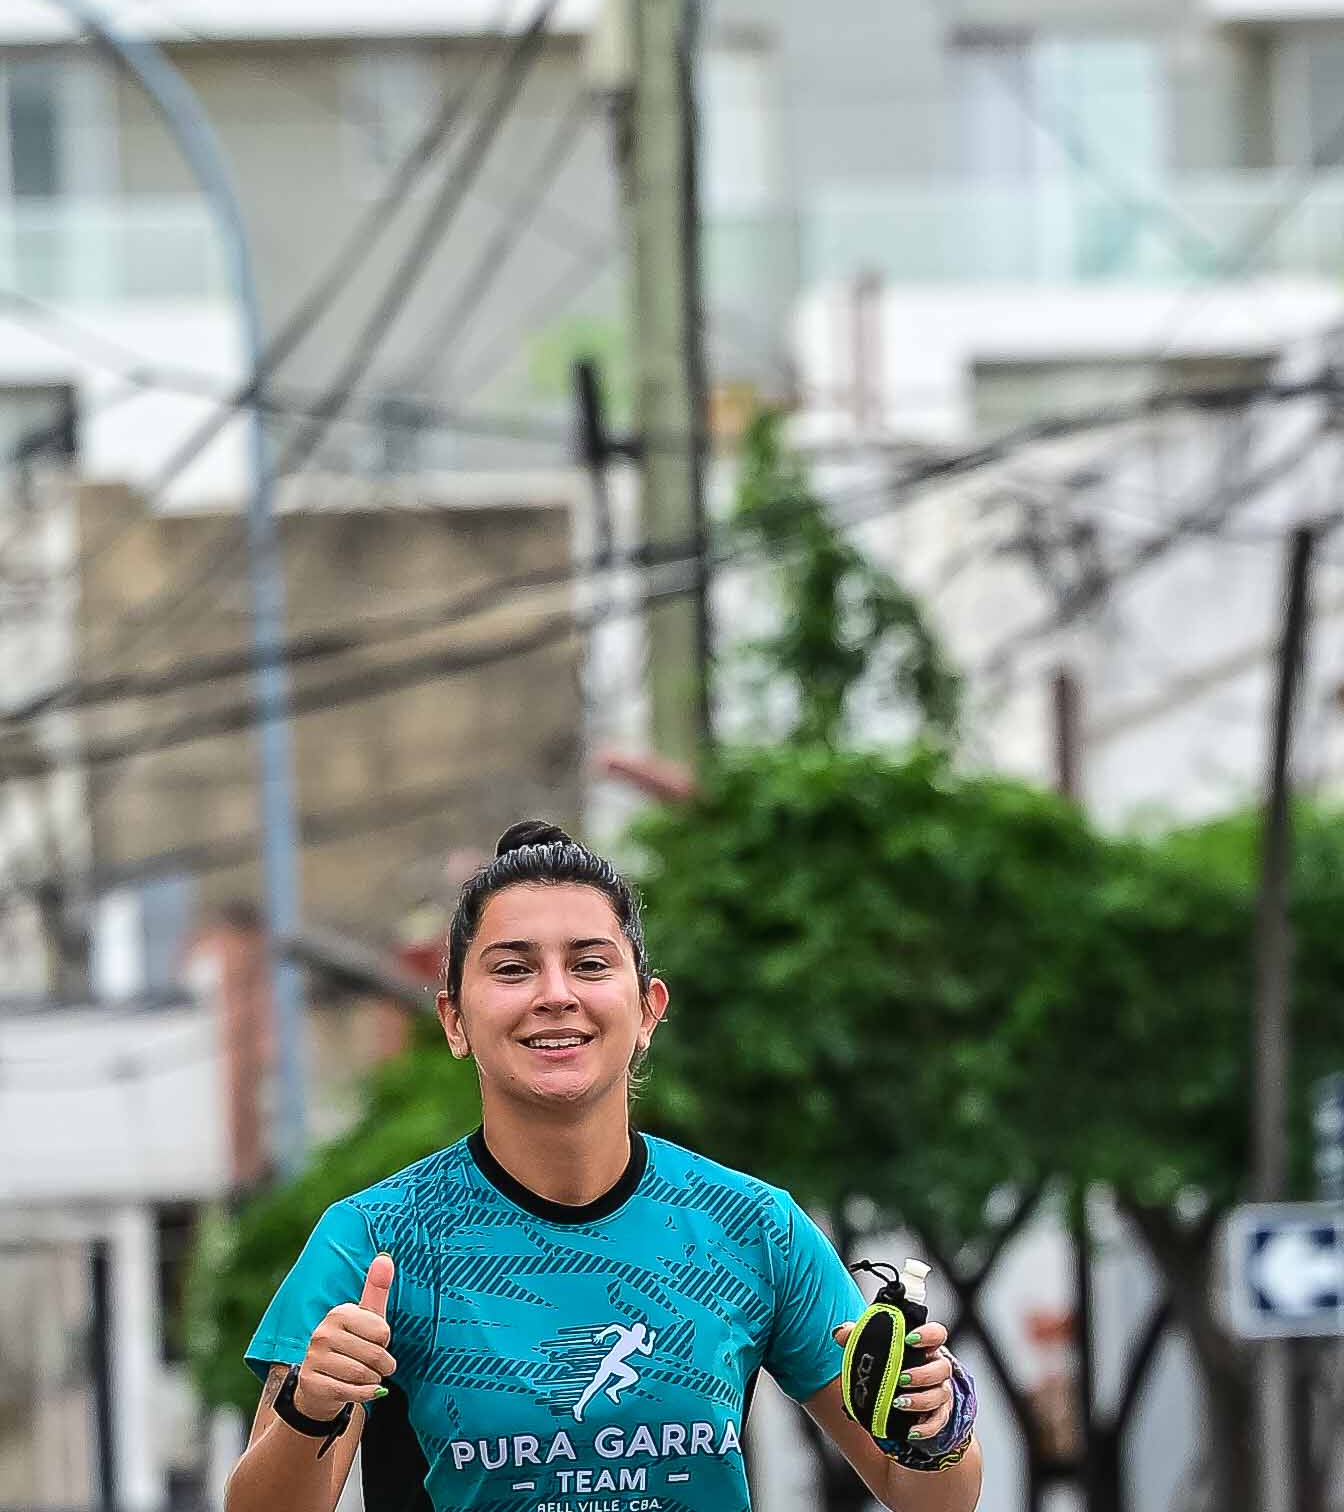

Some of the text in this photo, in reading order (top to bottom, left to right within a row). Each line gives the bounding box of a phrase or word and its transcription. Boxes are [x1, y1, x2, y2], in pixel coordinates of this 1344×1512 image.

[451, 1420, 743, 1470] PURA GARRA
[556, 1468, 647, 1493] TEAM
[579, 1499, 620, 1512] VILLE
